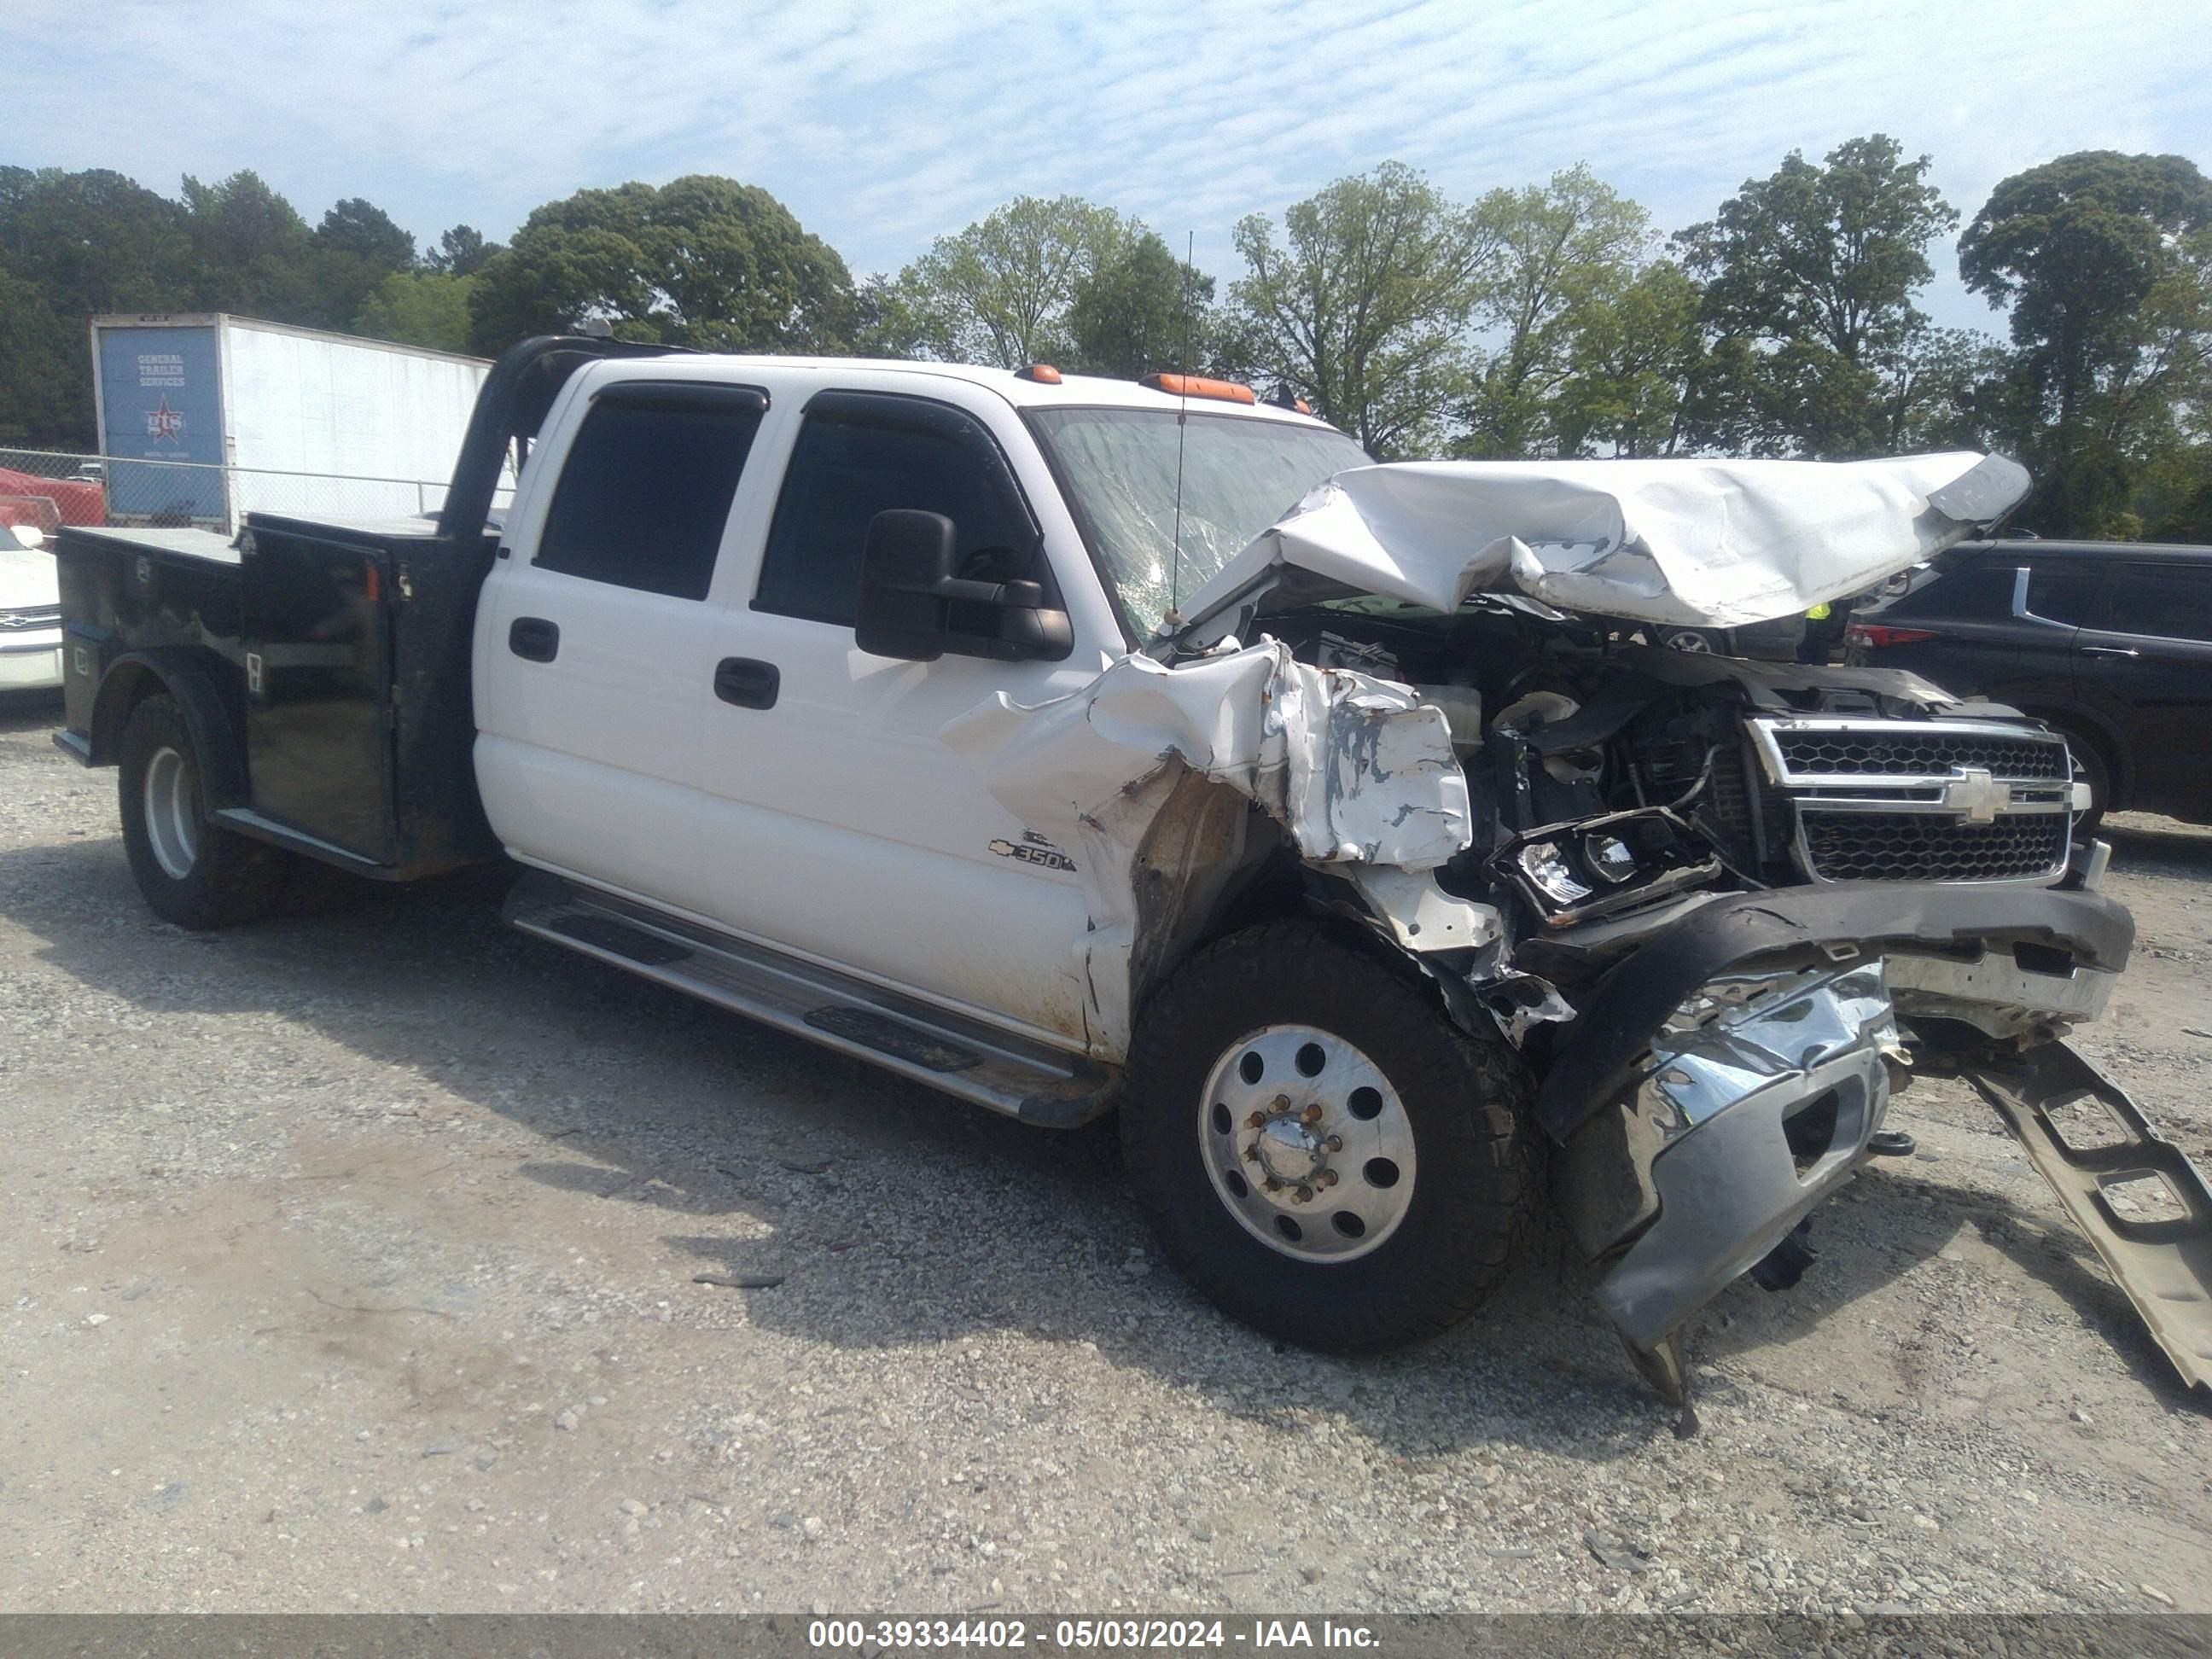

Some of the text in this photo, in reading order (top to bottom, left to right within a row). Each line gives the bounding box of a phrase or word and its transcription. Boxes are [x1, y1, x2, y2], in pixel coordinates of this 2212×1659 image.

[137, 354, 183, 364] GENERAL
[138, 365, 183, 375] TRAILER
[139, 376, 184, 387] SERVICES
